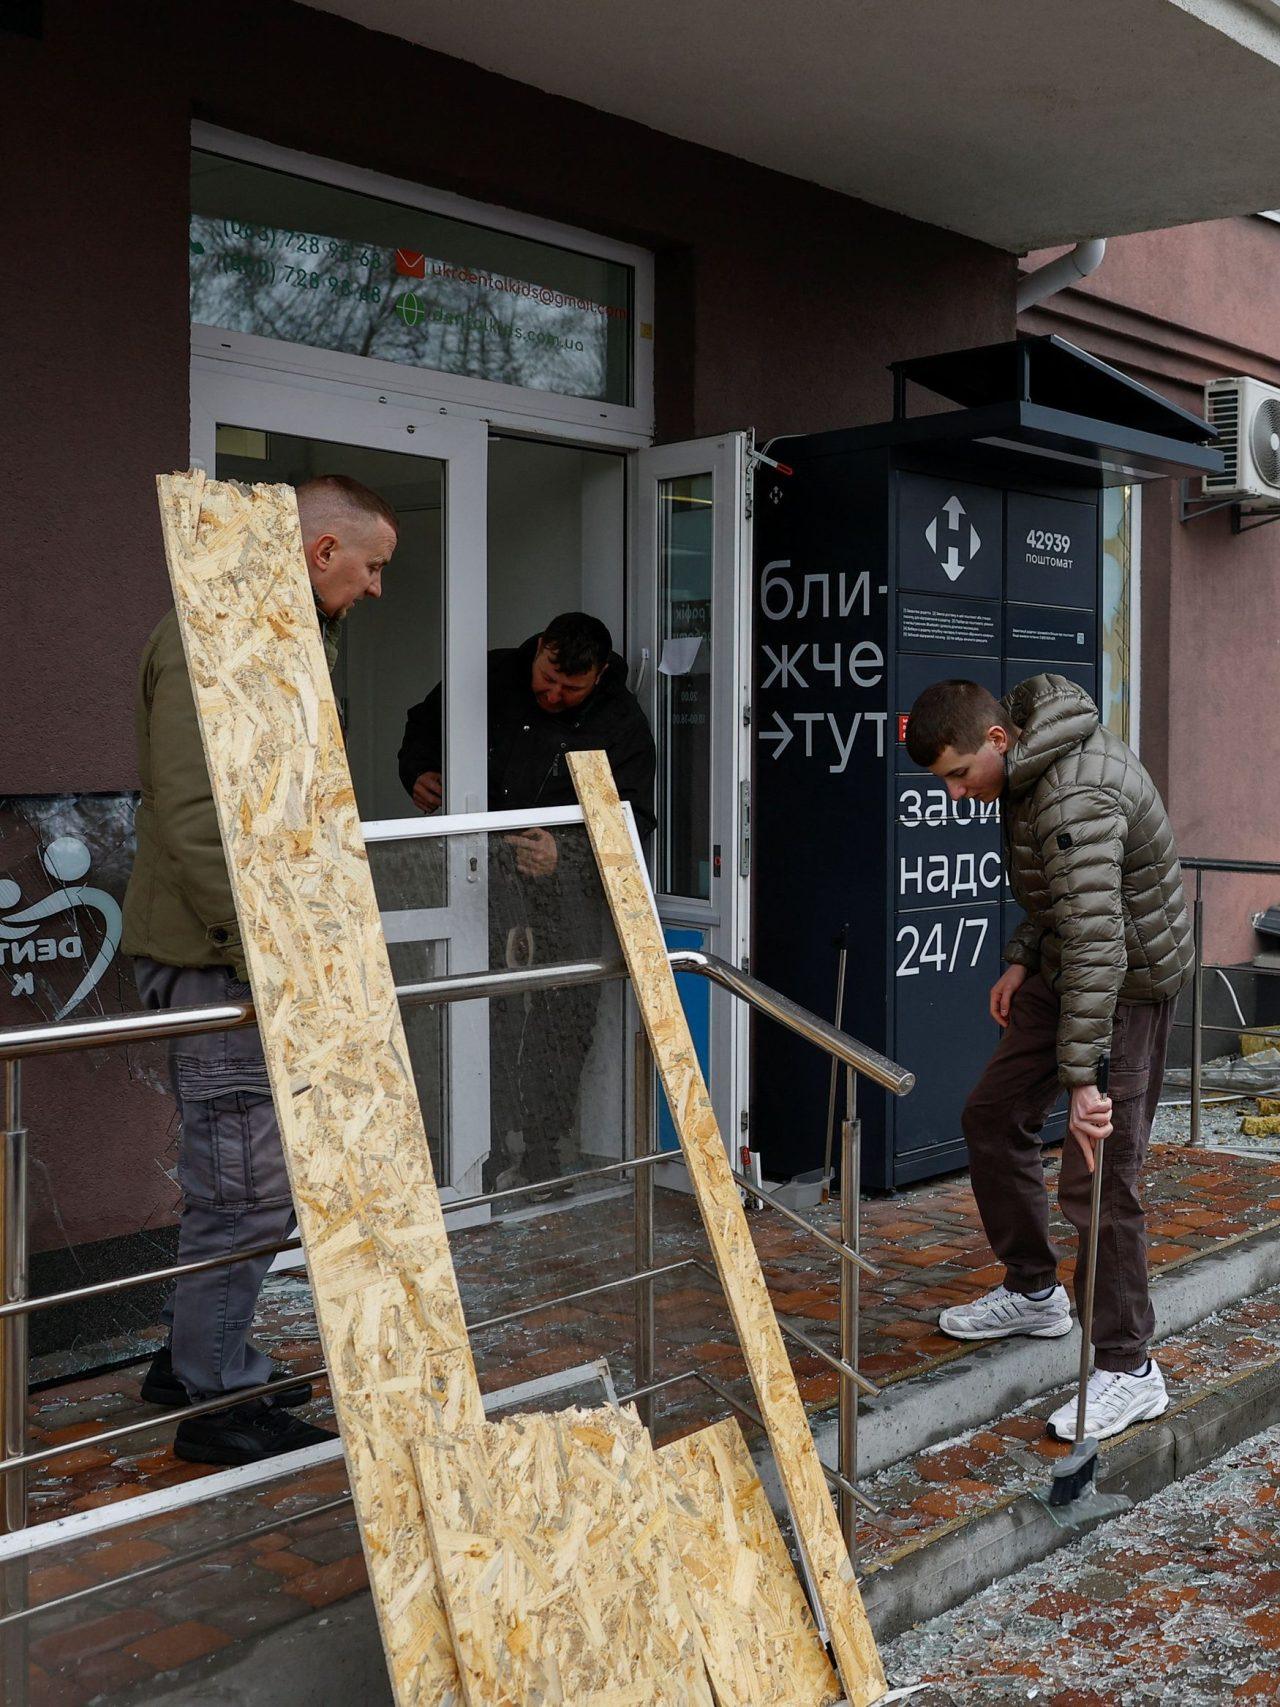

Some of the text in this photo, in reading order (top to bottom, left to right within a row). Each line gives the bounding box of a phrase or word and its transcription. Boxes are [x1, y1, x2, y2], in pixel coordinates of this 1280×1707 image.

[284, 228, 319, 254] 728
[360, 249, 380, 269] 68
[284, 264, 319, 289] 728
[328, 276, 351, 297] 98
[431, 262, 627, 320] ukrdentalkids@gmail.com
[1025, 552, 1073, 569] поштомат
[1026, 529, 1071, 554] 42939
[760, 559, 888, 621] бли-
[760, 640, 884, 689] жче
[794, 711, 887, 773] тут
[899, 789, 1001, 828] заби
[900, 851, 1010, 899] надс
[895, 917, 989, 977] 24/7
